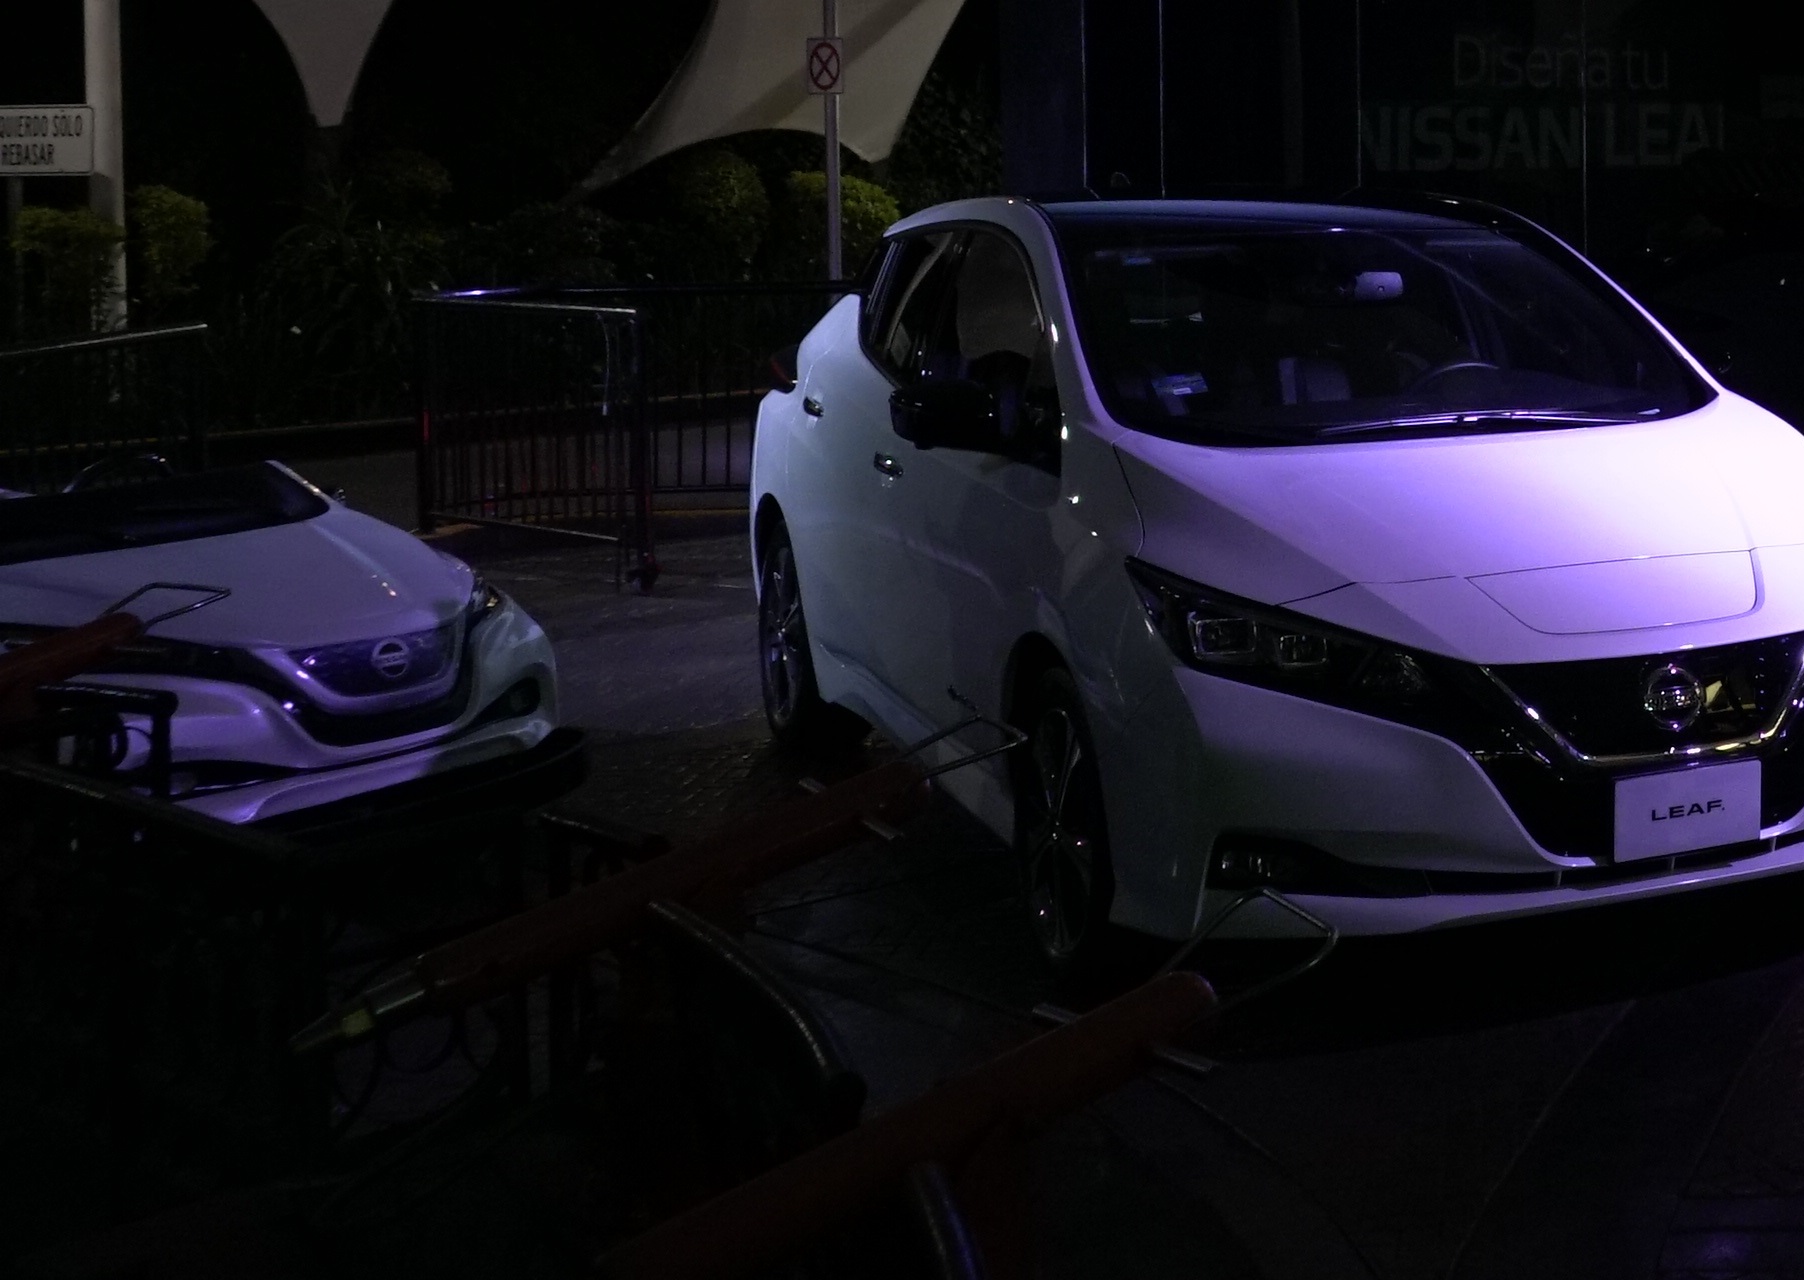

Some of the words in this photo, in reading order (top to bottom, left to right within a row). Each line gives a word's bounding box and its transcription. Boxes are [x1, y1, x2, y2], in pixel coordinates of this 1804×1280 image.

[1622, 40, 1670, 90] tu
[1358, 104, 1582, 173] NISSAN
[1651, 799, 1722, 821] LEAF
